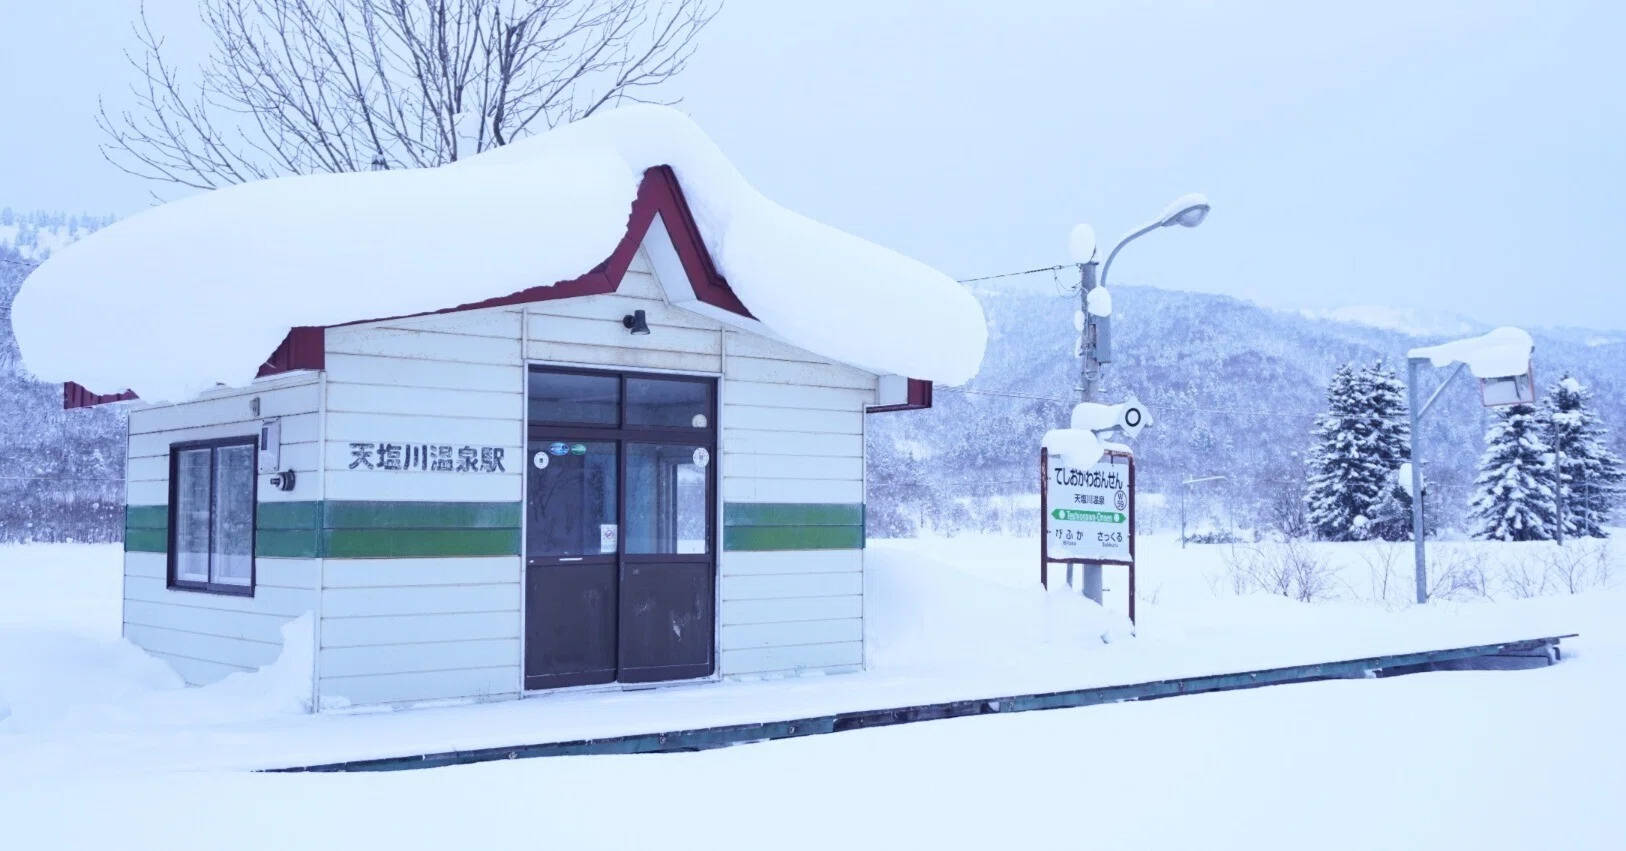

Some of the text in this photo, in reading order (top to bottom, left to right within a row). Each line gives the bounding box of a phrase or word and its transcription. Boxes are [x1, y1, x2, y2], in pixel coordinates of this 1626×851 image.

[348, 442, 505, 473] 天塩川温泉駅
[1074, 493, 1105, 505] 天塩川温泉
[1097, 531, 1123, 542] さっくる
